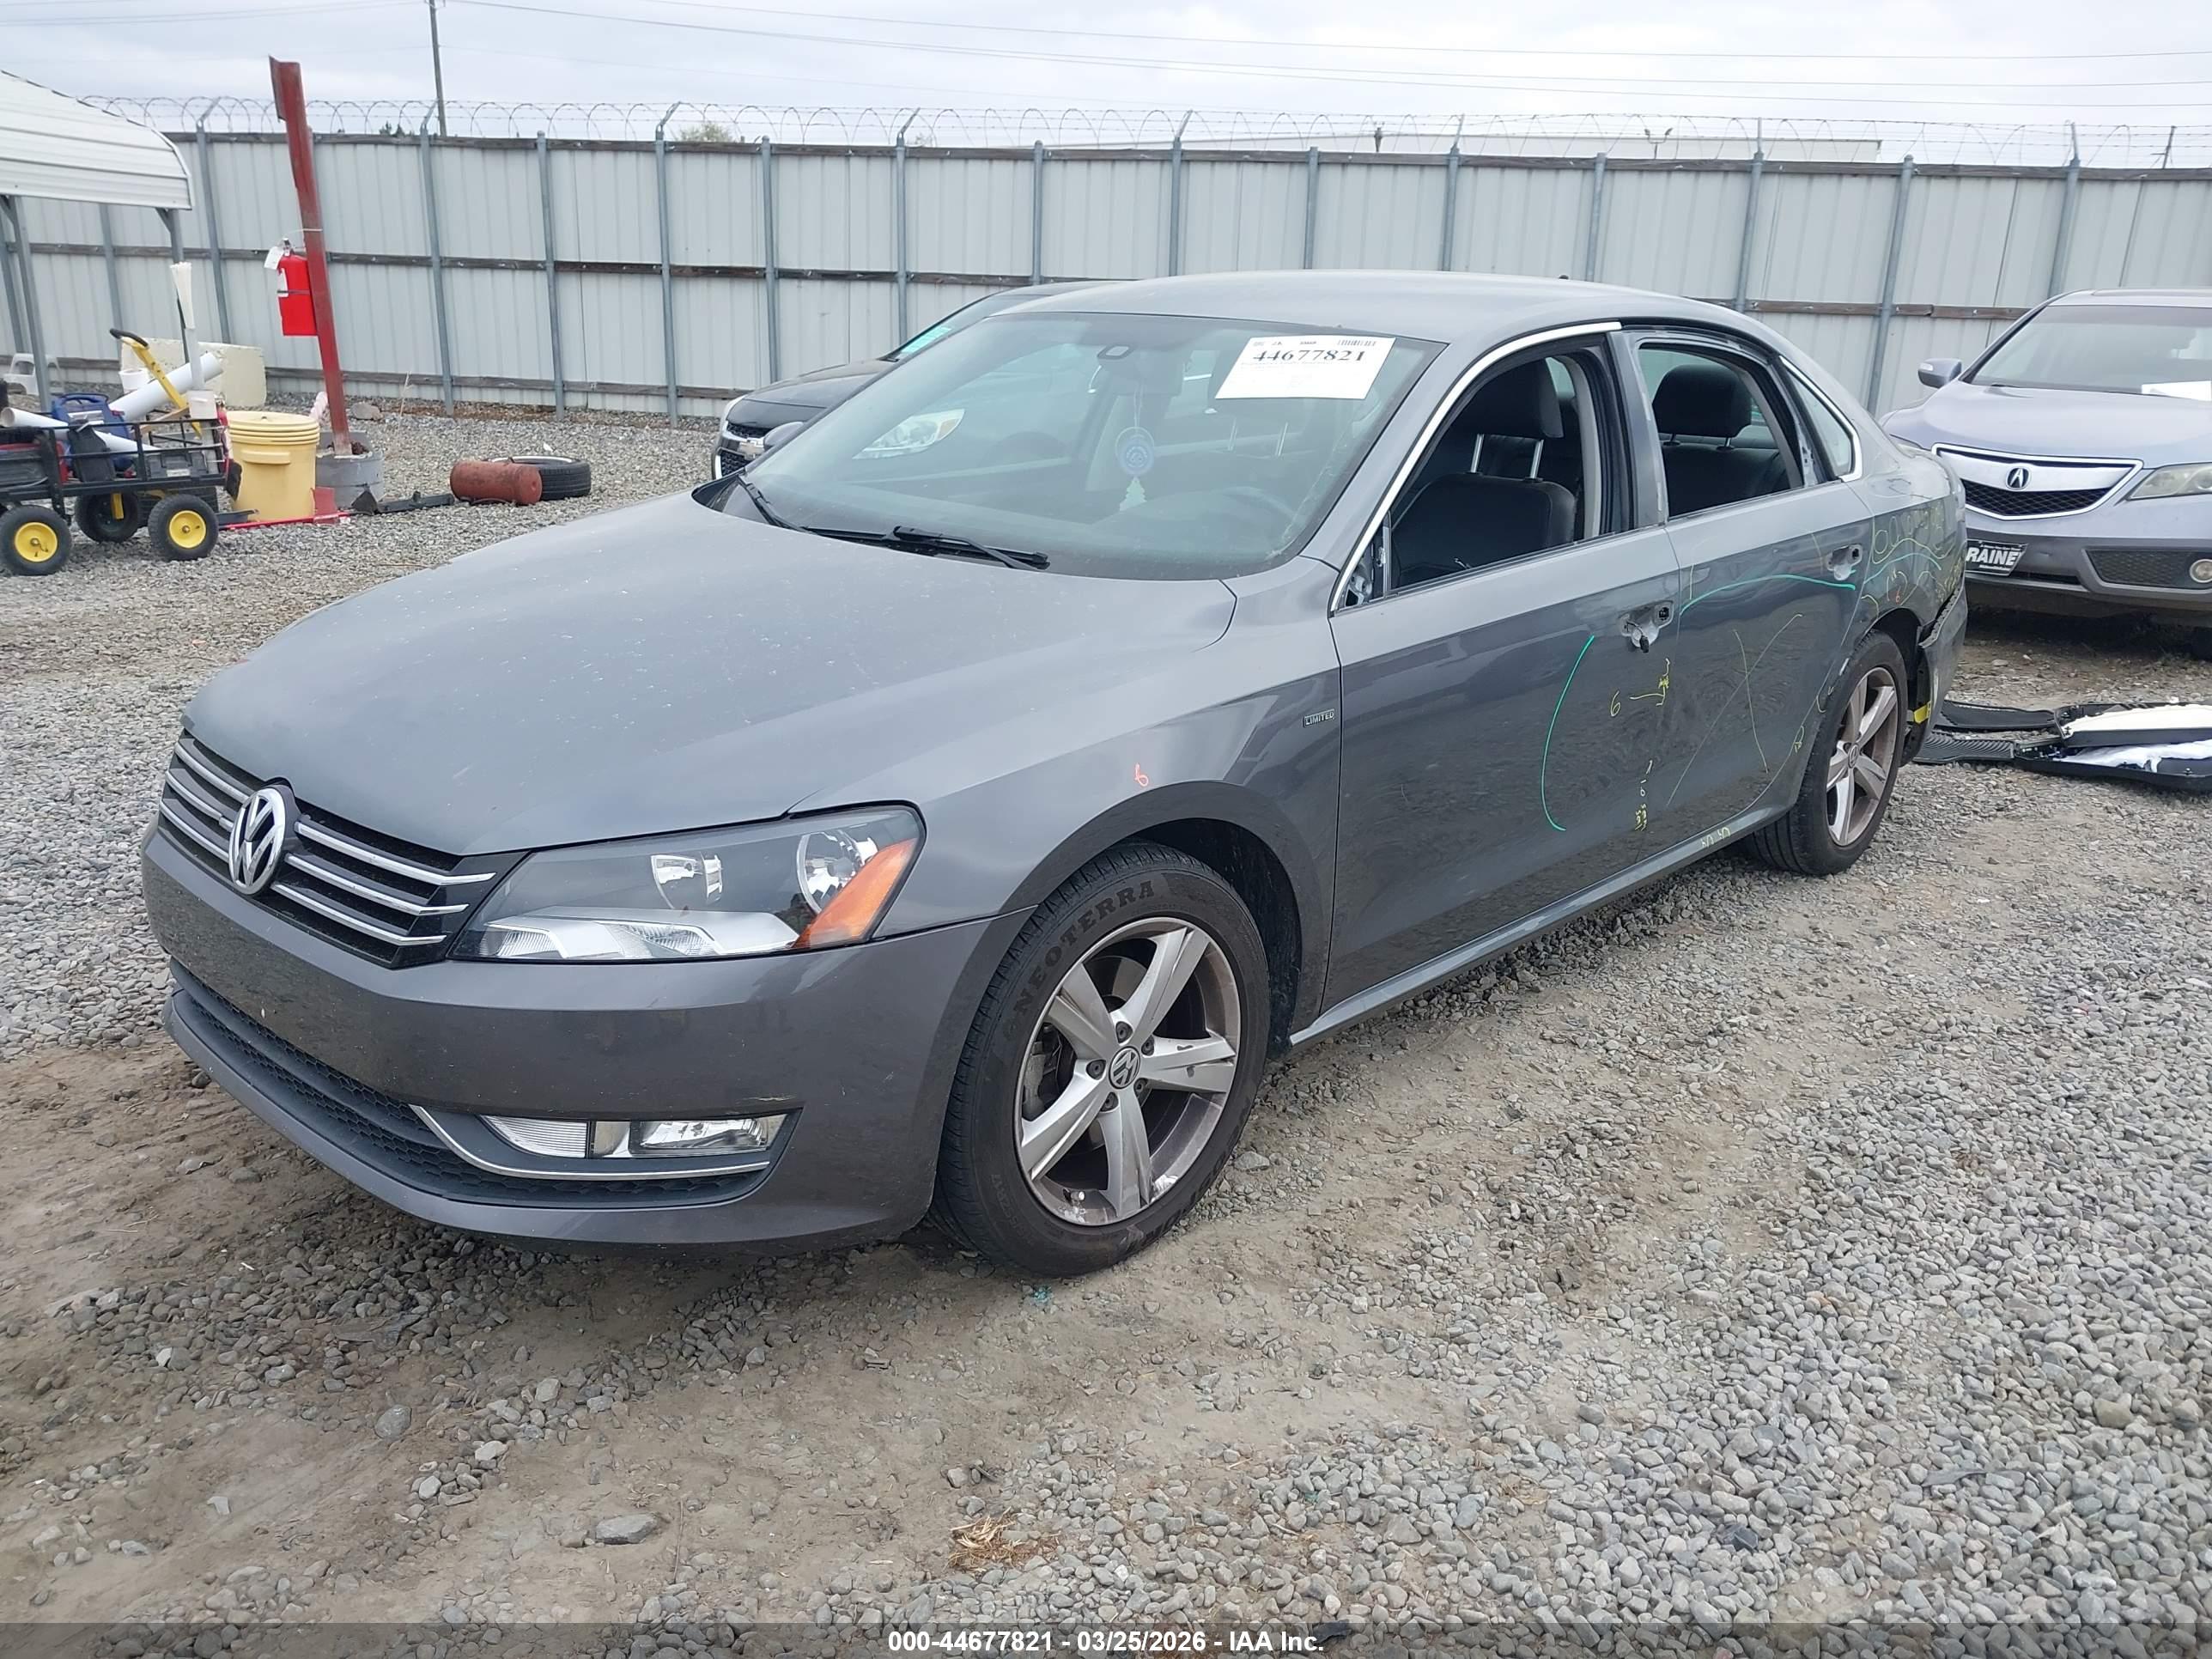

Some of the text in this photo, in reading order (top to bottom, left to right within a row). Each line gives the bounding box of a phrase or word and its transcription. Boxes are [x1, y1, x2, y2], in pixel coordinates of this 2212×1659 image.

[1253, 349, 1366, 362] 44677821
[1305, 711, 1334, 726] LIMITED
[1012, 880, 1156, 1015] NEOTERRA
